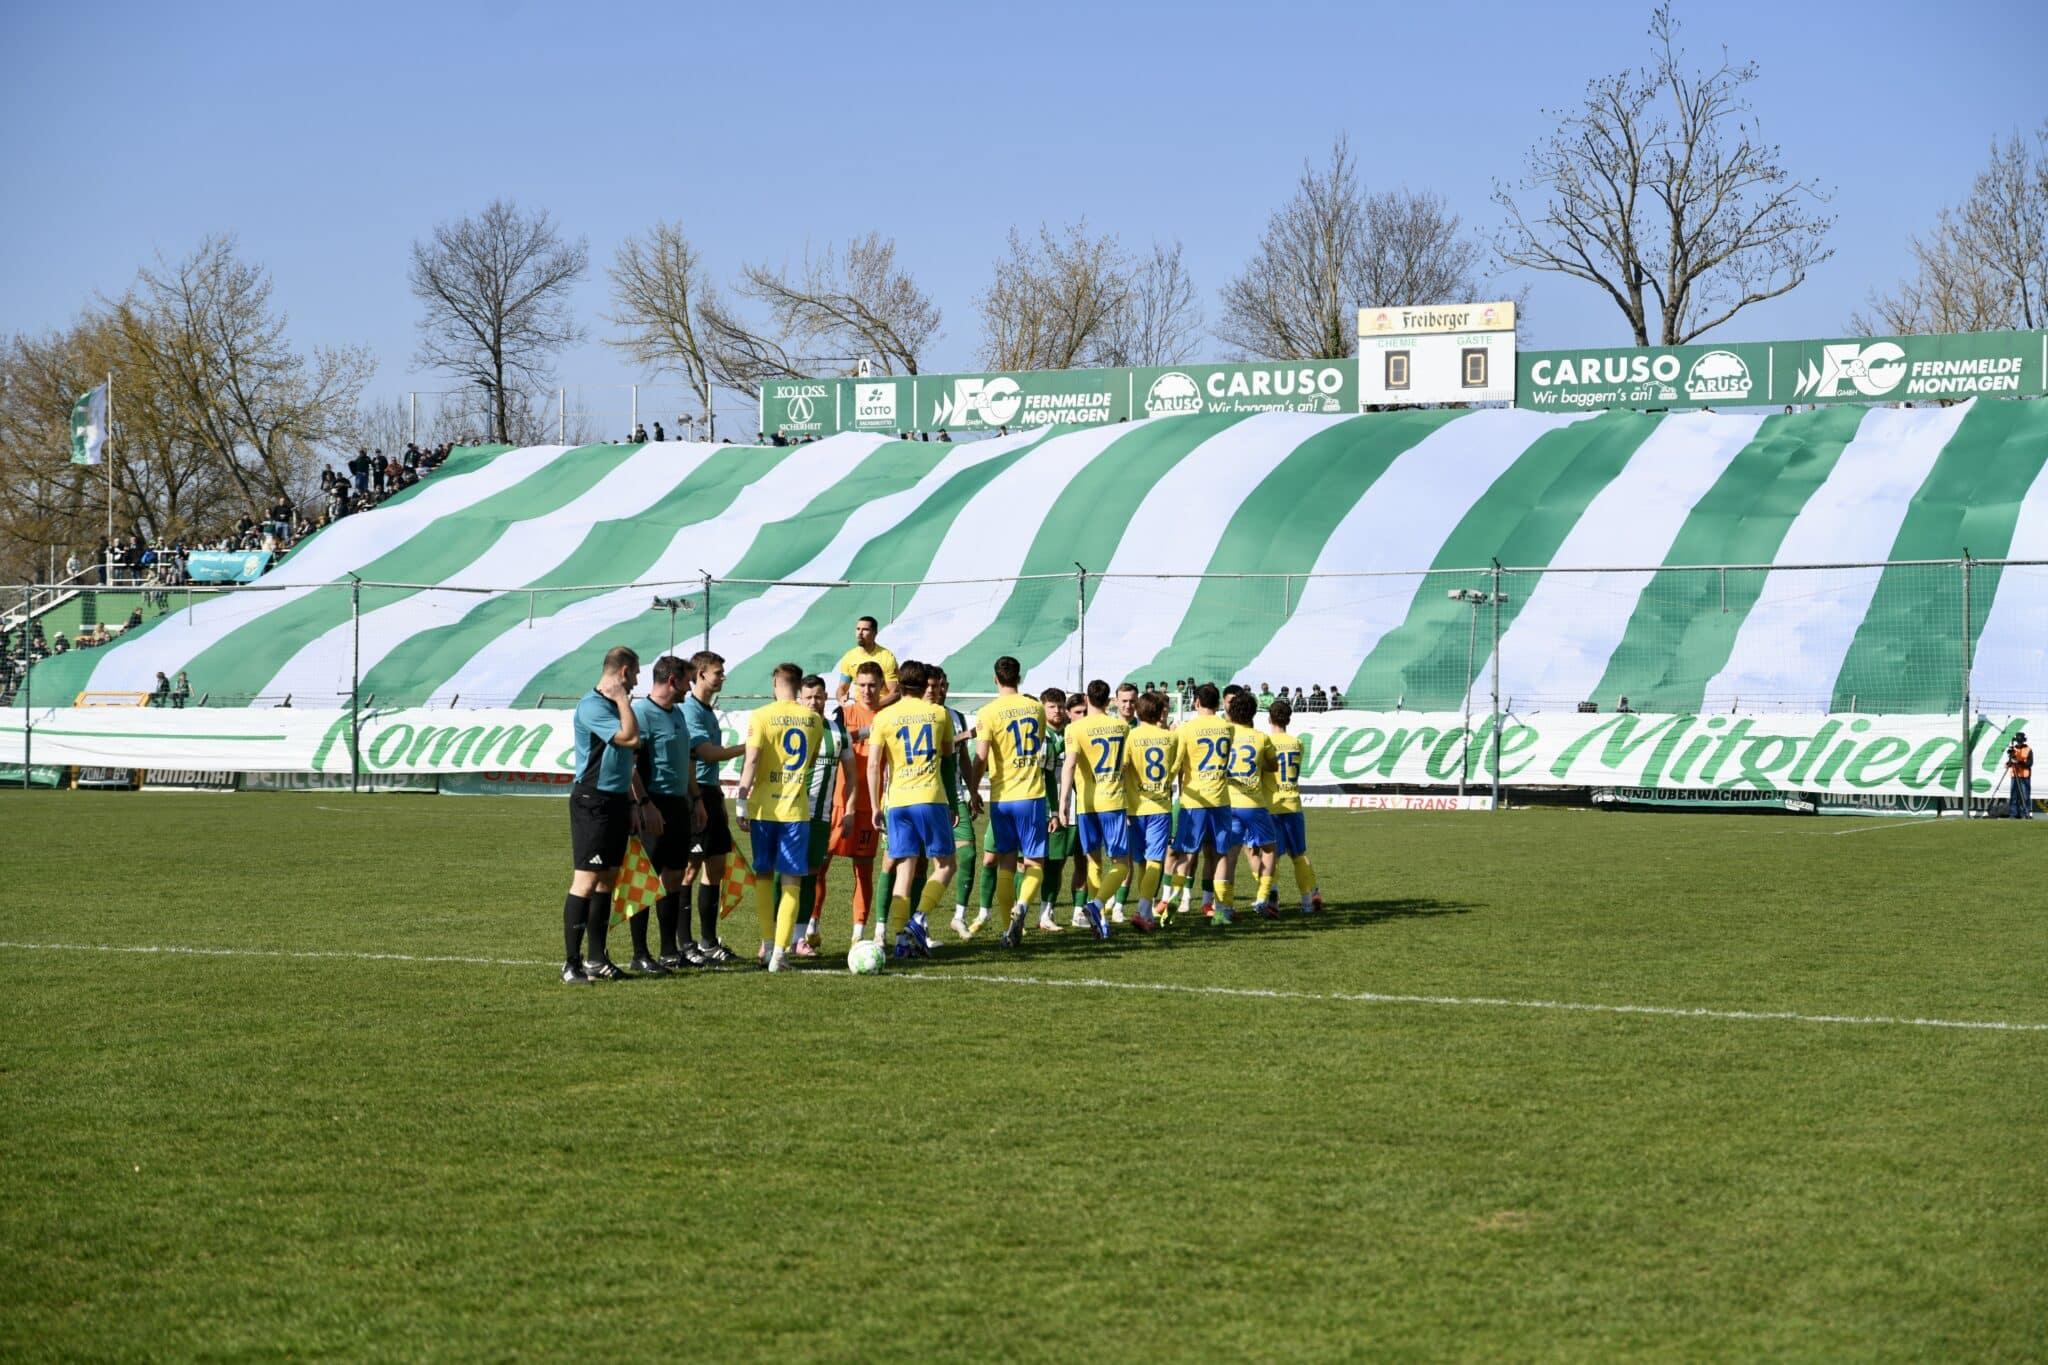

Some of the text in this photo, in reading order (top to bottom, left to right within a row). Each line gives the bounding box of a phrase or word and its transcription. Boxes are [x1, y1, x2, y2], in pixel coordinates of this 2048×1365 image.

[1402, 311, 1470, 330] Freiberger
[860, 361, 869, 374] A
[1389, 353, 1484, 385] 0 0
[1531, 355, 1681, 386] CARUSO
[1911, 357, 2023, 377] FERNMELDE
[777, 385, 825, 397] KOLOSS
[1207, 367, 1344, 397] CARUSO
[1684, 379, 1753, 393] CARUSO
[1907, 375, 2020, 394] MONTAGEN
[1025, 392, 1112, 409] FERNMELDE
[1144, 397, 1204, 411] CARUSO
[1208, 401, 1231, 413] Wir
[1298, 399, 1318, 412] an!
[1532, 388, 1653, 407] Wir baggern's an!
[860, 405, 892, 416] LOTTO
[1021, 408, 1110, 425] MONTAGEN
[896, 724, 937, 765] 14
[1006, 717, 1041, 757] 13
[783, 727, 808, 771] 9
[1091, 736, 1125, 773] 27
[1197, 737, 1231, 771] 29
[1549, 713, 2029, 794] Mitglied!
[1145, 747, 1167, 782] 8
[1227, 745, 1257, 777] 23
[1276, 752, 1300, 783] 15
[1405, 797, 1459, 810] TRANS
[1622, 788, 1652, 800] UND
[861, 831, 872, 844] 37
